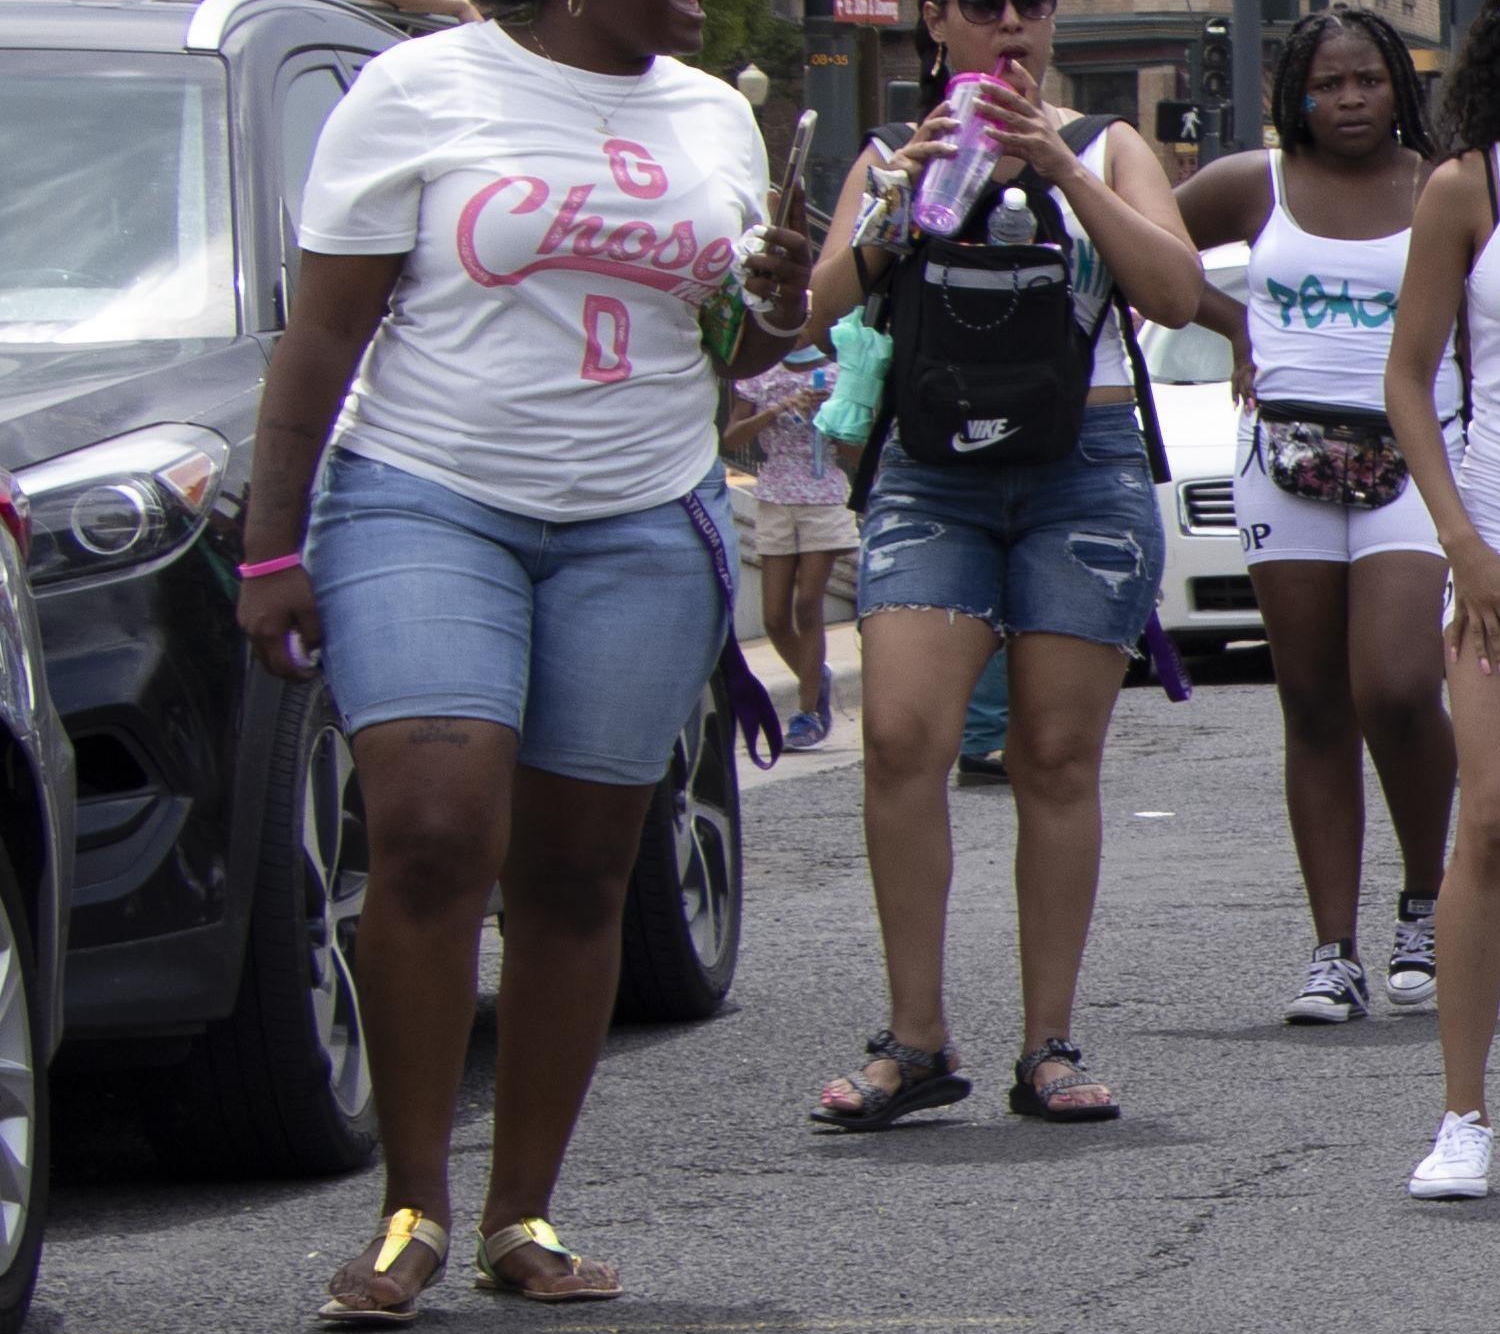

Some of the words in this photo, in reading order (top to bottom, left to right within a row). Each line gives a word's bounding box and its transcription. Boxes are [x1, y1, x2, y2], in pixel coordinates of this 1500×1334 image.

[603, 138, 668, 199] G
[457, 175, 735, 288] Chose
[1266, 274, 1398, 329] PEAC
[580, 294, 632, 384] D
[966, 418, 1008, 439] NIKE
